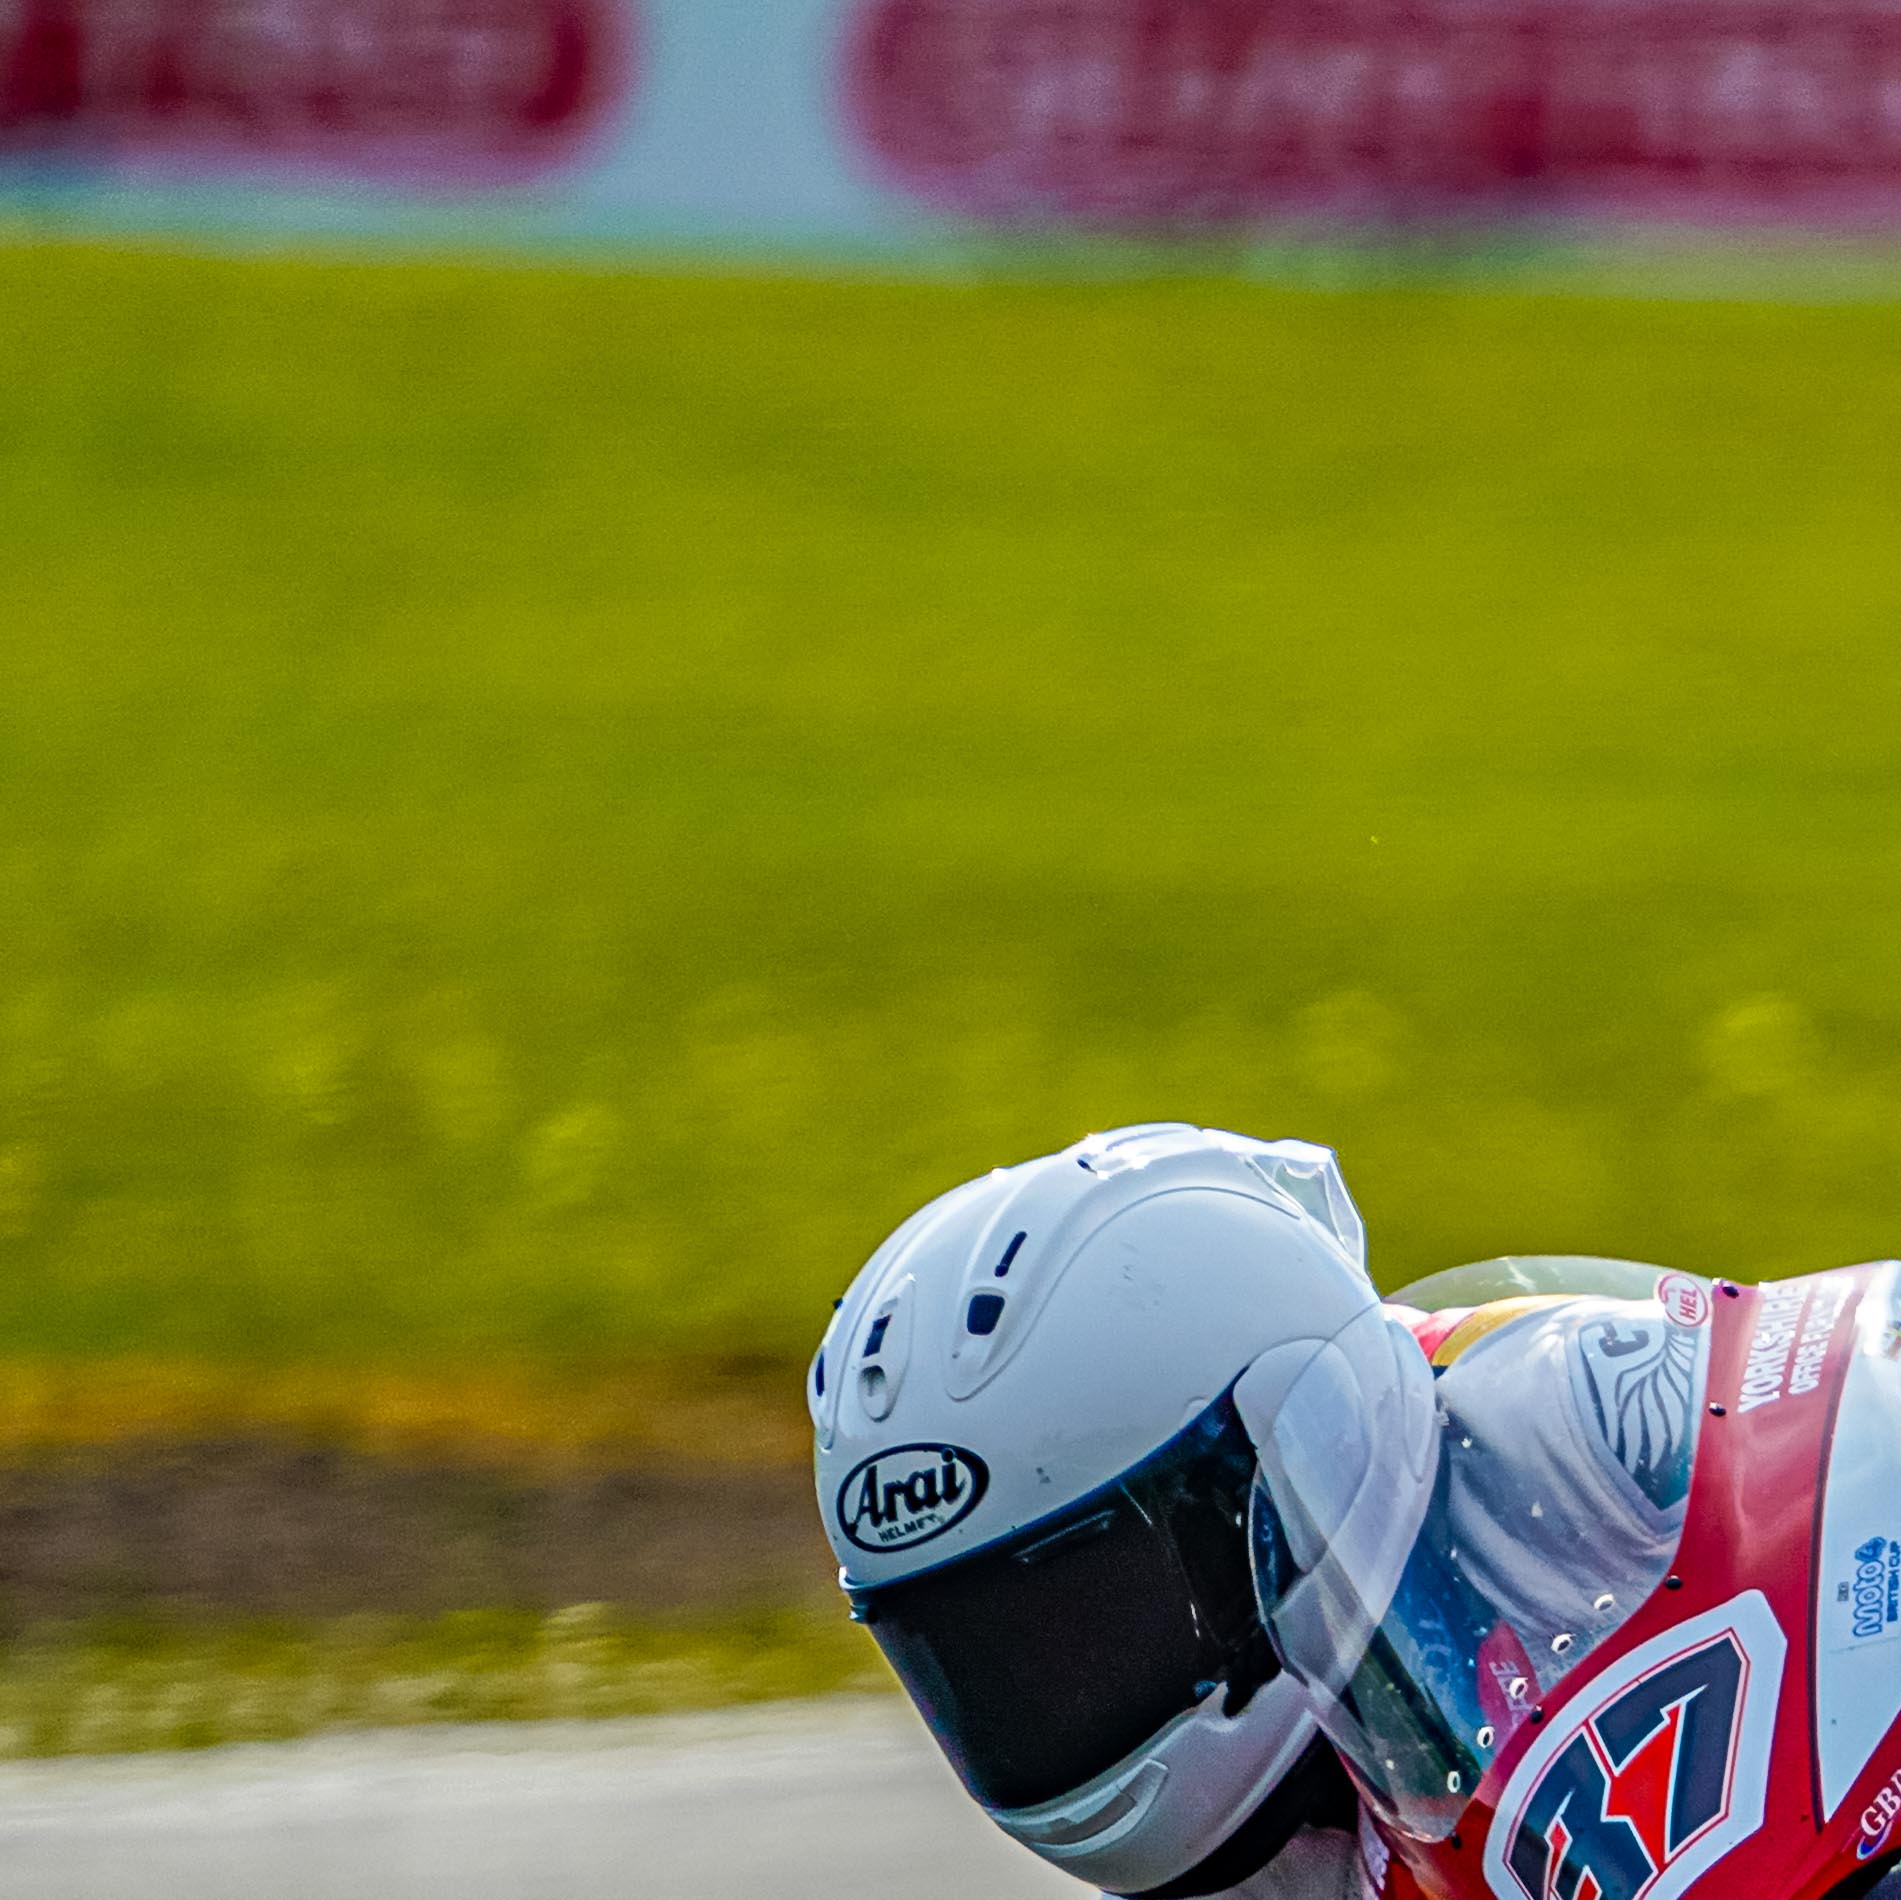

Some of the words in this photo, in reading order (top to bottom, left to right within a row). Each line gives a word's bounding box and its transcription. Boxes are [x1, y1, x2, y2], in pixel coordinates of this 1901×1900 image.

[1678, 1287, 1698, 1321] HEL
[1737, 1282, 1812, 1413] YORKSHIRE
[1787, 1342, 1828, 1395] OFFICE
[848, 1448, 967, 1536] Arai
[1853, 1536, 1887, 1637] Moto4
